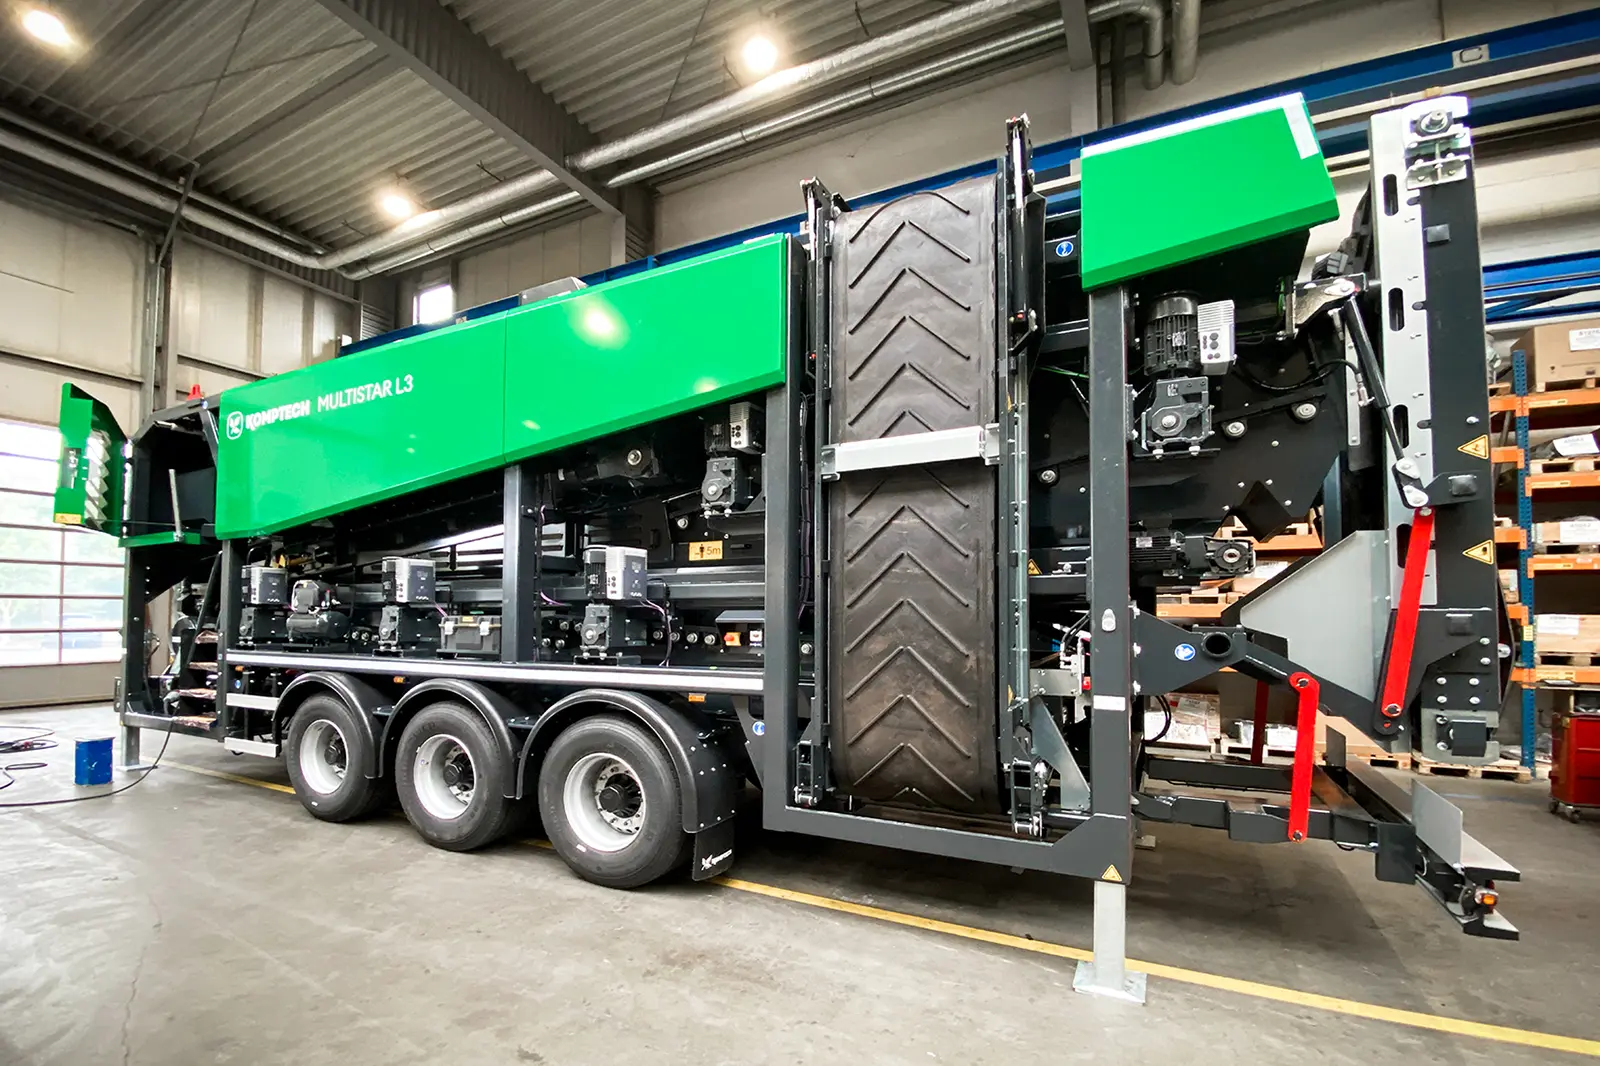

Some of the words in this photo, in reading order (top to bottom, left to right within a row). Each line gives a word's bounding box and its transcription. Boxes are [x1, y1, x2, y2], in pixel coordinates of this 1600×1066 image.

[1460, 47, 1483, 63] C
[245, 399, 310, 431] KOMPTECH
[317, 379, 393, 412] MULTISTAR
[395, 374, 414, 394] L3
